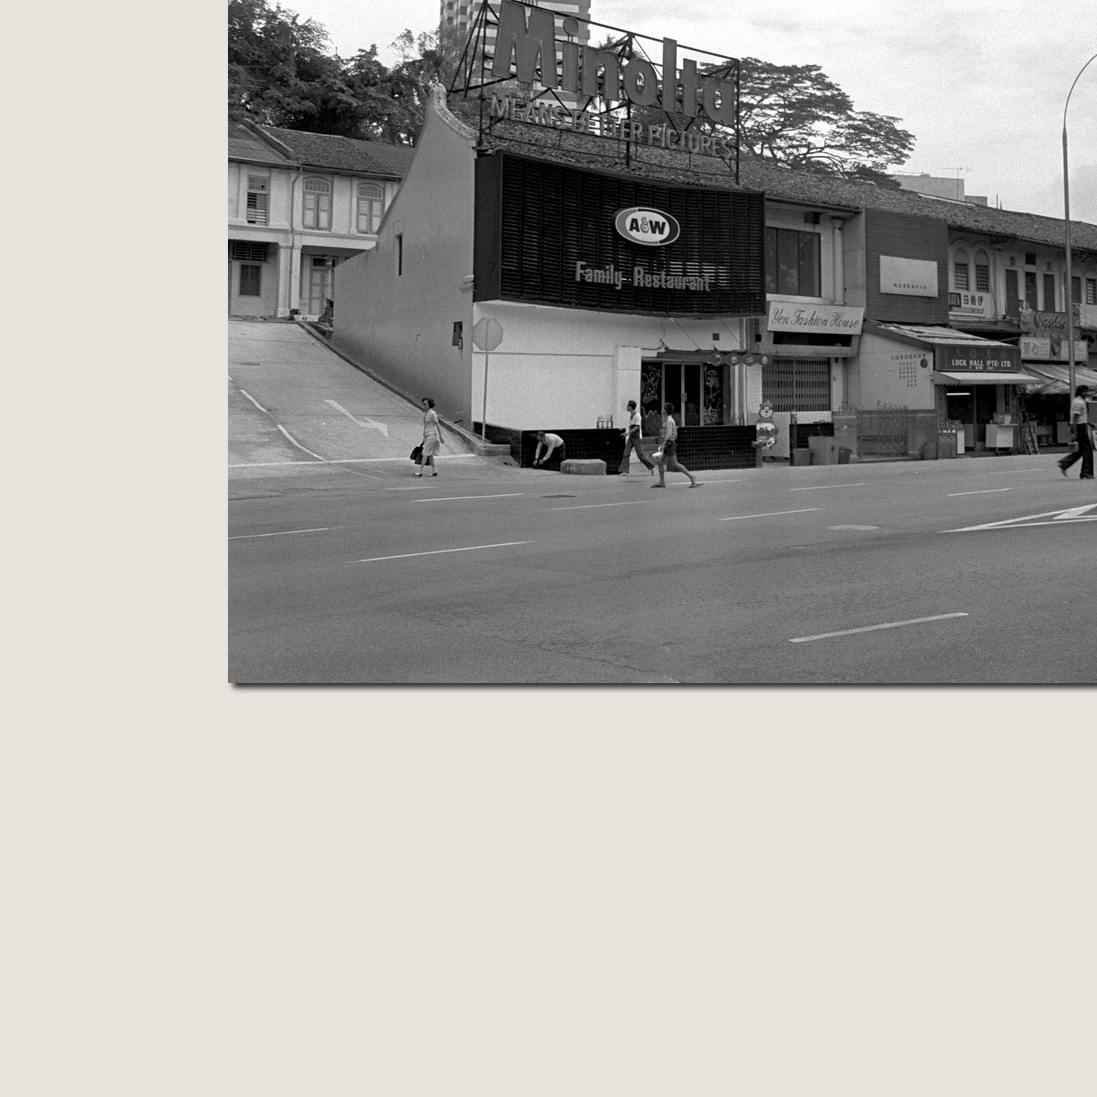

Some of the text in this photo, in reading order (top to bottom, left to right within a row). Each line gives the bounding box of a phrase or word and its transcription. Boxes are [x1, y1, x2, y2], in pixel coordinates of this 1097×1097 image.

[491, 0, 736, 125] Minolta
[490, 93, 733, 159] MEANS BETTER PICTURES
[629, 217, 666, 235] A&W
[575, 261, 710, 292] Family Restaurant
[771, 307, 860, 329] Yen Fashion House
[951, 359, 967, 367] LUCK
[969, 359, 984, 367] HALL
